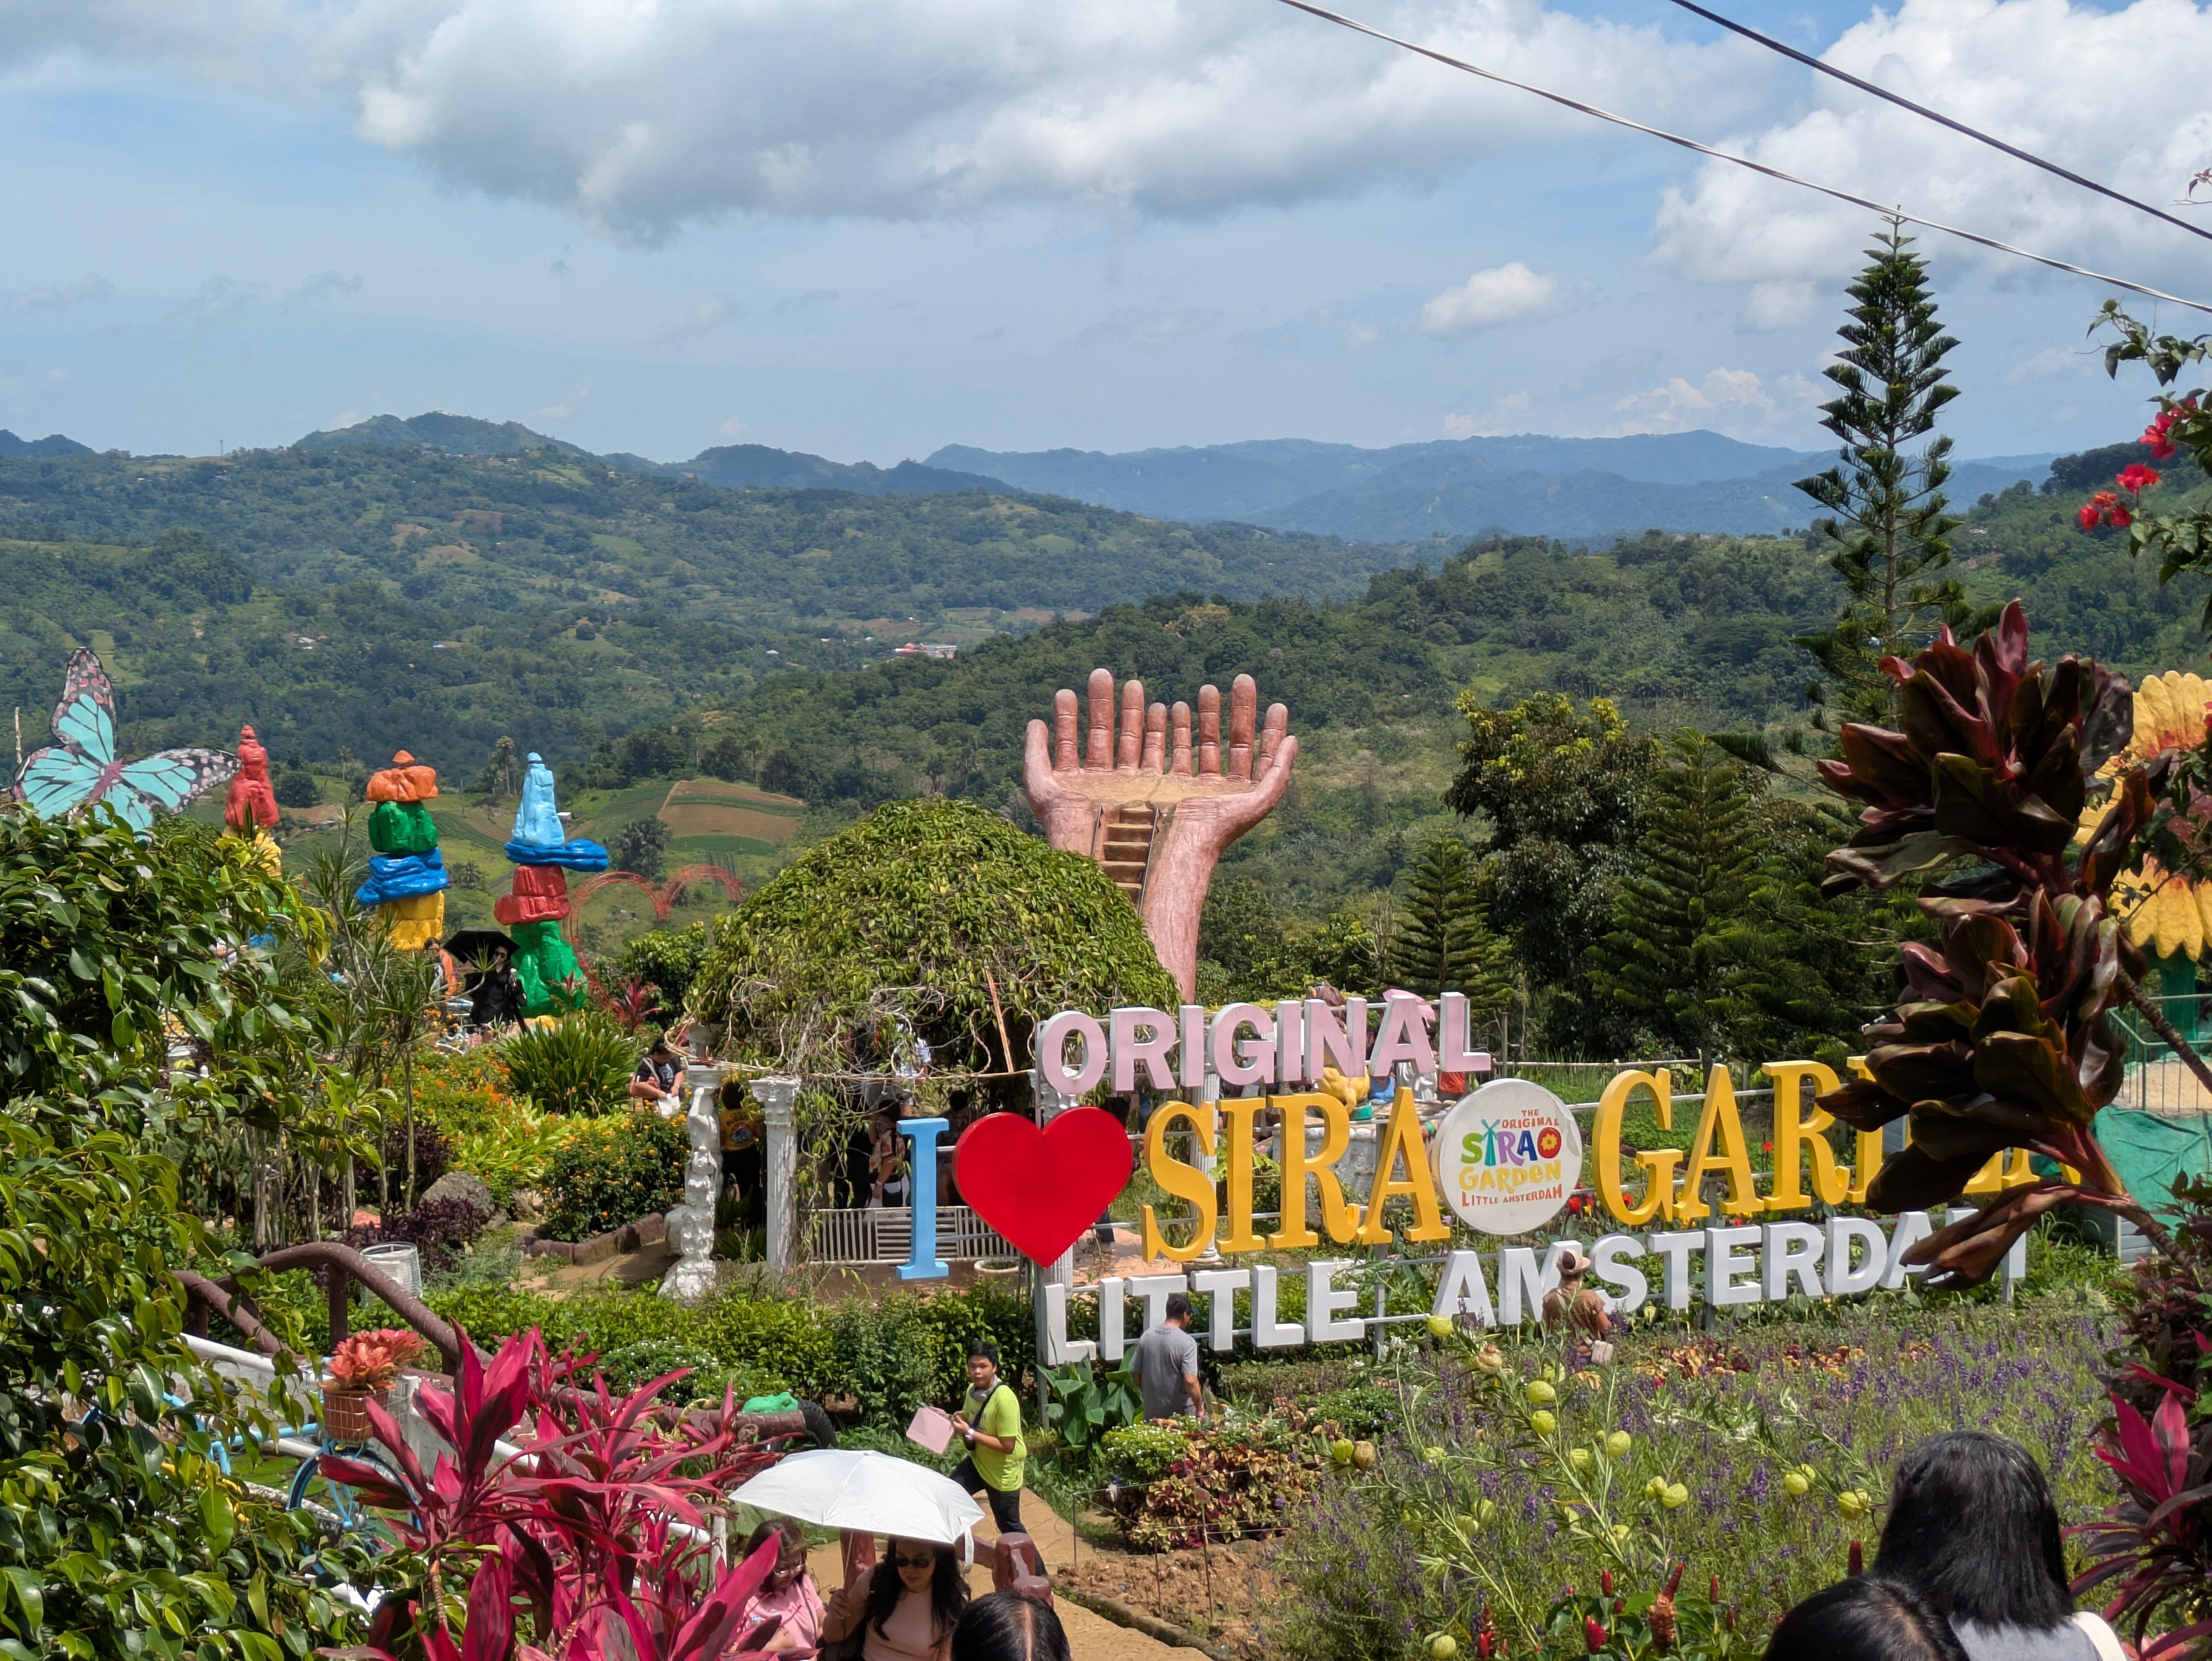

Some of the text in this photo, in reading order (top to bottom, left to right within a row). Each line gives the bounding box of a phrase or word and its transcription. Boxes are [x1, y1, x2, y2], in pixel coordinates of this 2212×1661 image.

[1037, 992, 1491, 1094] ORIGINAL
[1460, 1119, 1561, 1166] SIRAO
[1502, 1117, 1559, 1128] ORIGINAL
[896, 1118, 949, 1279] I
[1141, 1087, 1450, 1264] SIRA
[1462, 1184, 1562, 1206] LITTLE AMSTERDAM
[1043, 1259, 1364, 1366] LITTLE
